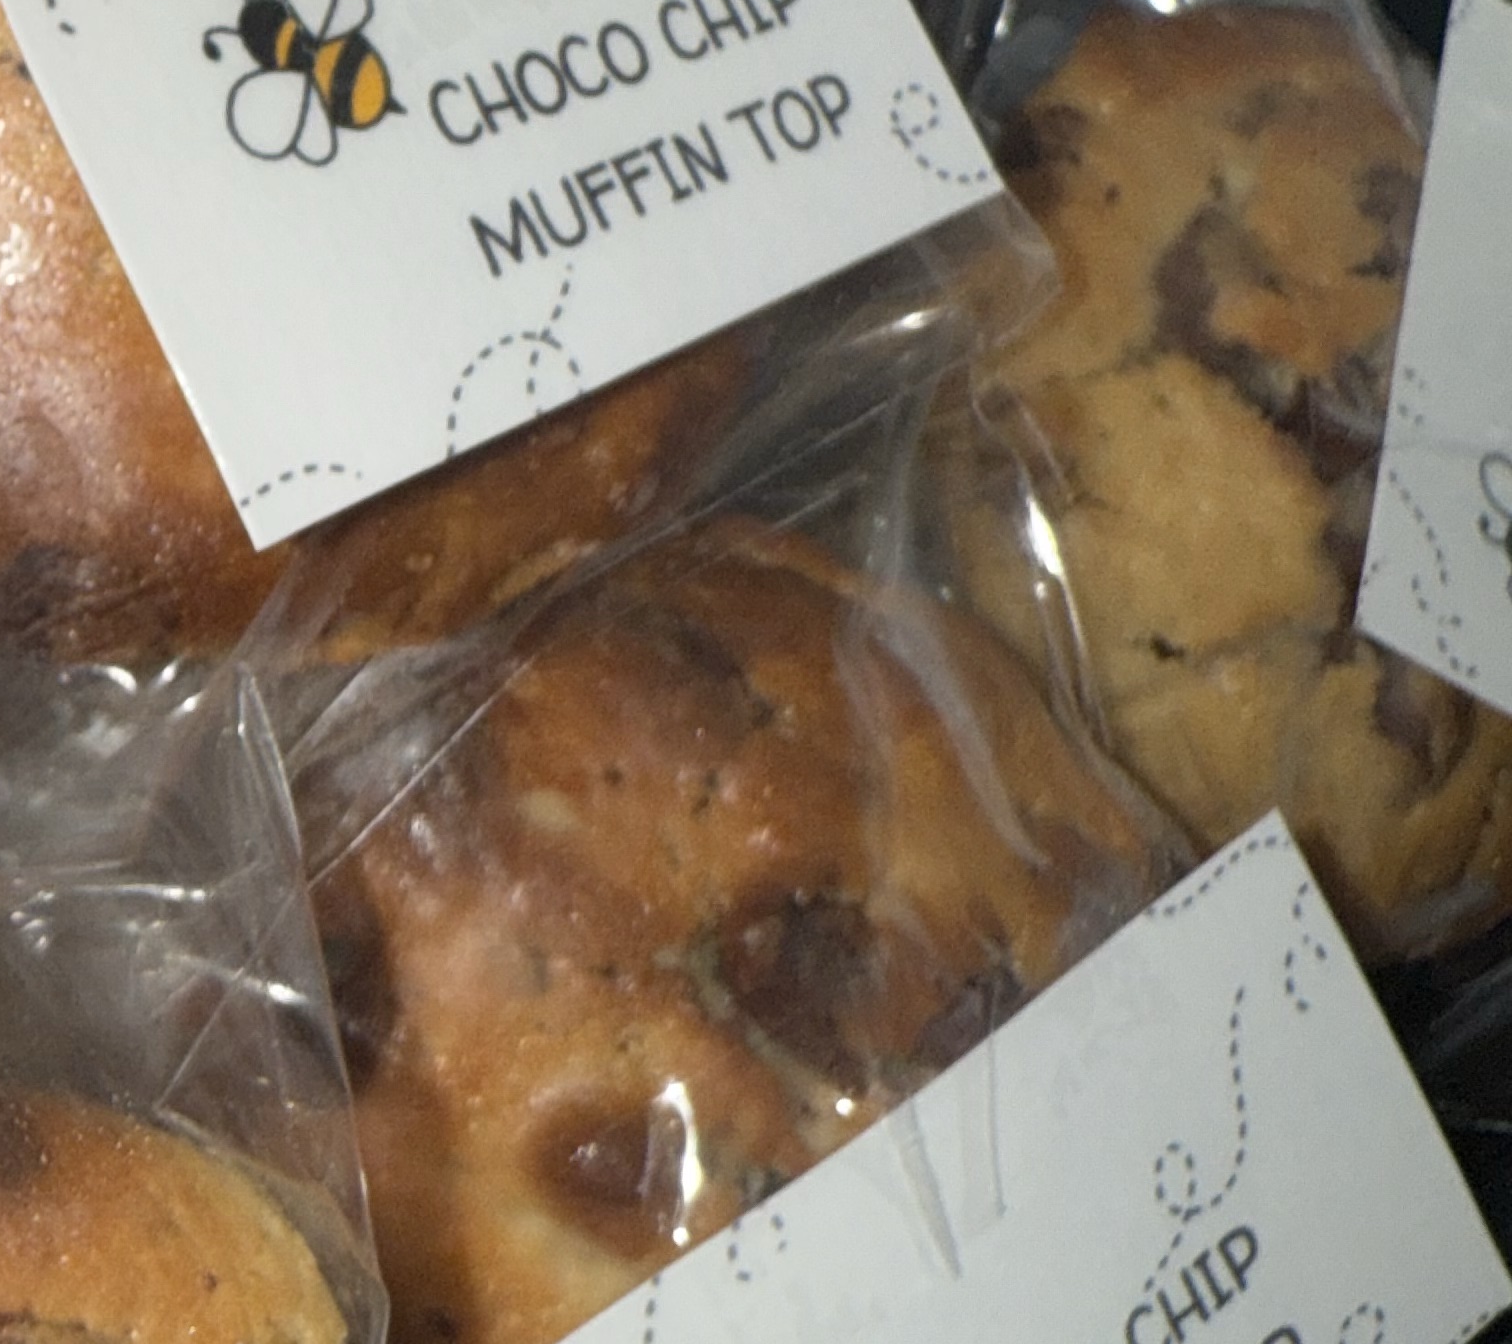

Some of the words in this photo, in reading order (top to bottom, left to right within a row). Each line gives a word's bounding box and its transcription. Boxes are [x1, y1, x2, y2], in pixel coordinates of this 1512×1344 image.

[428, 21, 649, 146] CHOCO
[469, 122, 729, 278] MUFFIN
[725, 73, 851, 163] TOP
